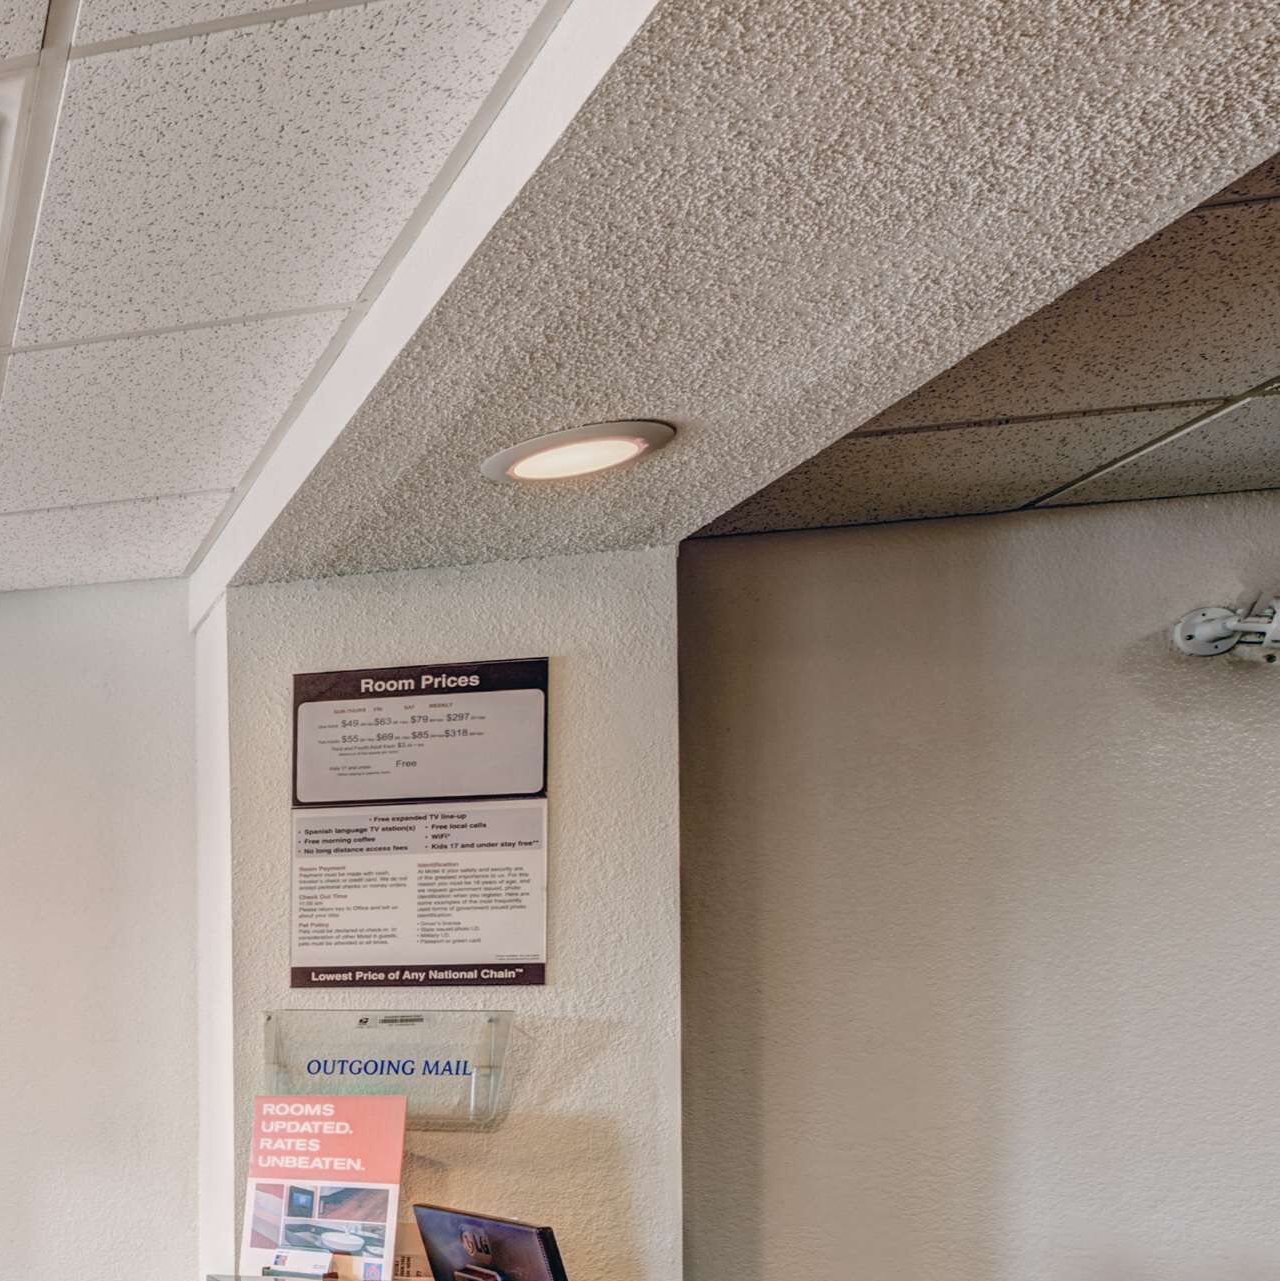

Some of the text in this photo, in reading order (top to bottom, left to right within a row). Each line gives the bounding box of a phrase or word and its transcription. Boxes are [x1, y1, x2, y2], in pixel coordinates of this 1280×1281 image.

[361, 674, 480, 692] Room Prices
[446, 713, 470, 722] $297
[341, 735, 359, 744] $55
[396, 760, 417, 768] Free
[311, 971, 352, 981] Lowest
[355, 971, 385, 981] Price
[388, 970, 399, 980] of
[403, 970, 424, 982] Any
[429, 968, 477, 980] National
[307, 1059, 473, 1076] OUTGOING MAIL
[262, 1103, 335, 1117] ROOMS
[261, 1121, 353, 1135] UPDATED.
[259, 1138, 321, 1152] RATES
[258, 1156, 366, 1171] UNBEATEN.
